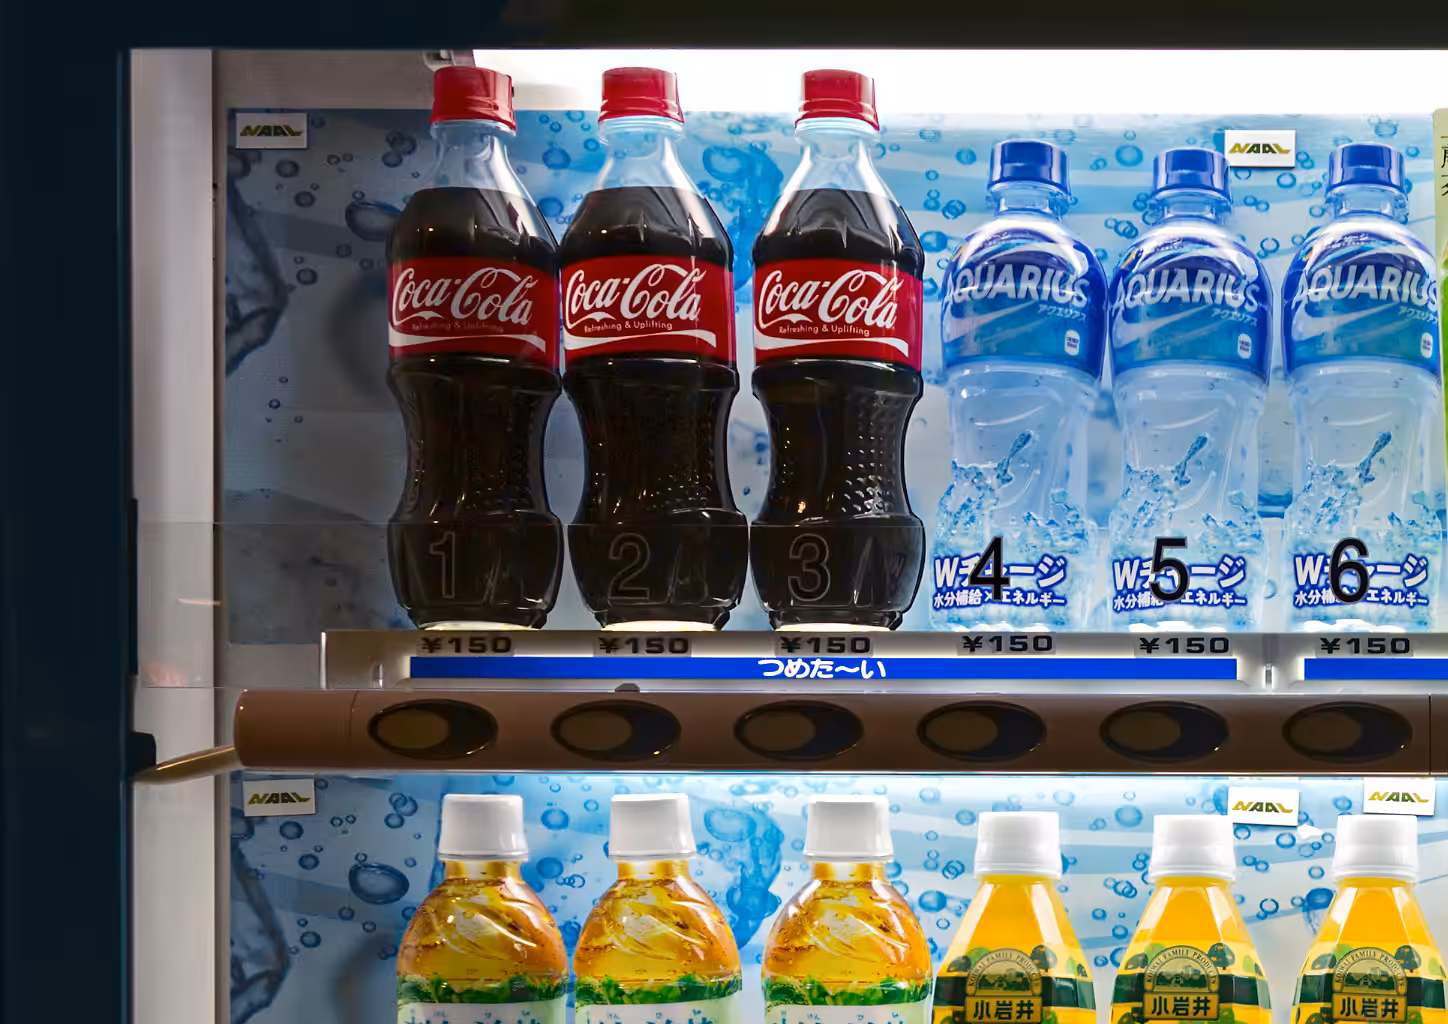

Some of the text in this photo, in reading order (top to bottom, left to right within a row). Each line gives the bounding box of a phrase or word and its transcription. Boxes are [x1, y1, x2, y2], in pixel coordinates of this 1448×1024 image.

[393, 266, 541, 327] Coca-Cola
[565, 264, 708, 329] Coca-Cola
[757, 269, 905, 331] Coca-Cola
[429, 532, 458, 600] 1
[608, 532, 652, 601] 2
[788, 534, 831, 601] 3
[969, 536, 1011, 601] 4
[1150, 536, 1189, 602] 5
[1328, 537, 1371, 604] 6
[422, 637, 512, 655] ¥150
[600, 637, 690, 655] ¥150
[781, 637, 871, 655] ¥150
[962, 636, 1052, 653] ¥150
[1140, 637, 1230, 654] ¥150
[1320, 637, 1410, 654] ¥150
[974, 1000, 1034, 1021] 小岩井
[1151, 996, 1211, 1017] 小岩井
[1340, 998, 1399, 1019] 小岩井
